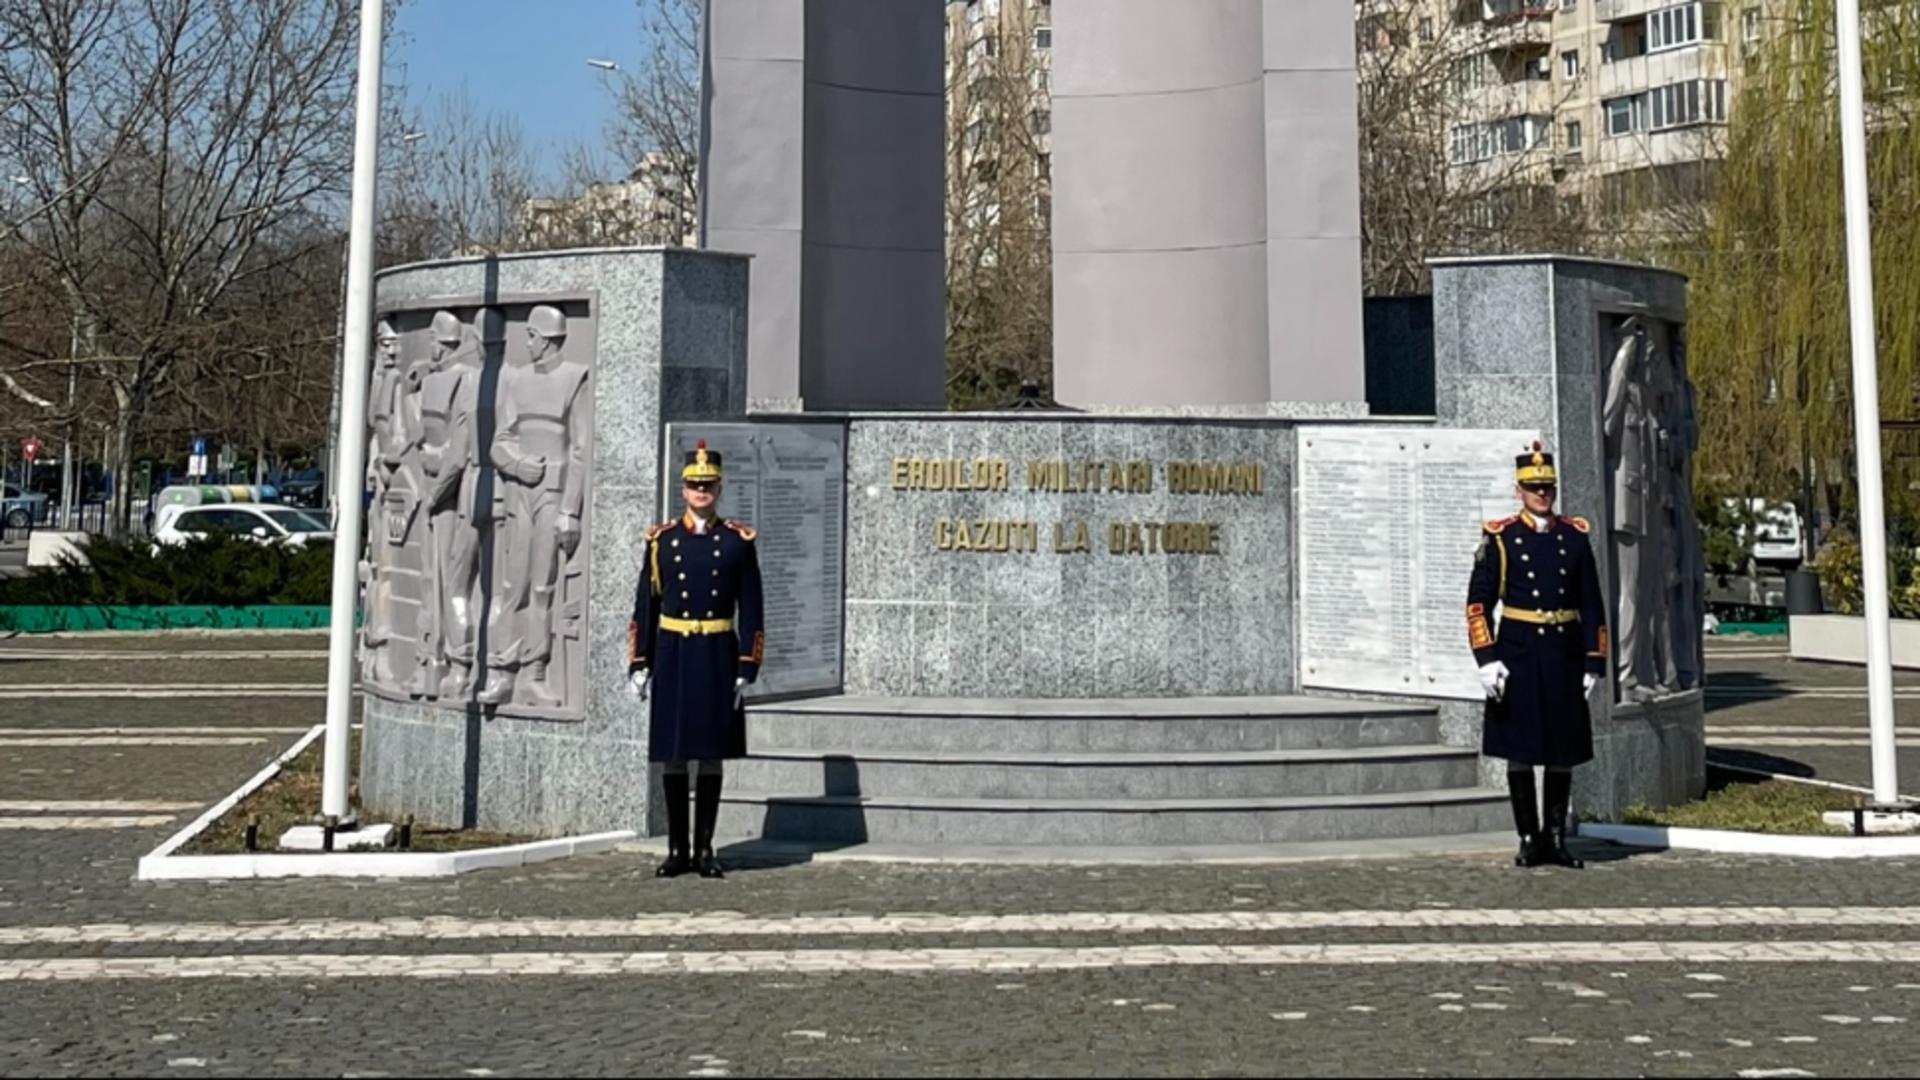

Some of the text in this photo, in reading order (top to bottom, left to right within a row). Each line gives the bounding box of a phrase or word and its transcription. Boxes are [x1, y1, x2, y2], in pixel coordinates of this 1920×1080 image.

[891, 457, 1264, 496] EROILOR MILITARI ROMANI
[935, 517, 1221, 555] CAZUTI LA DATORIE
